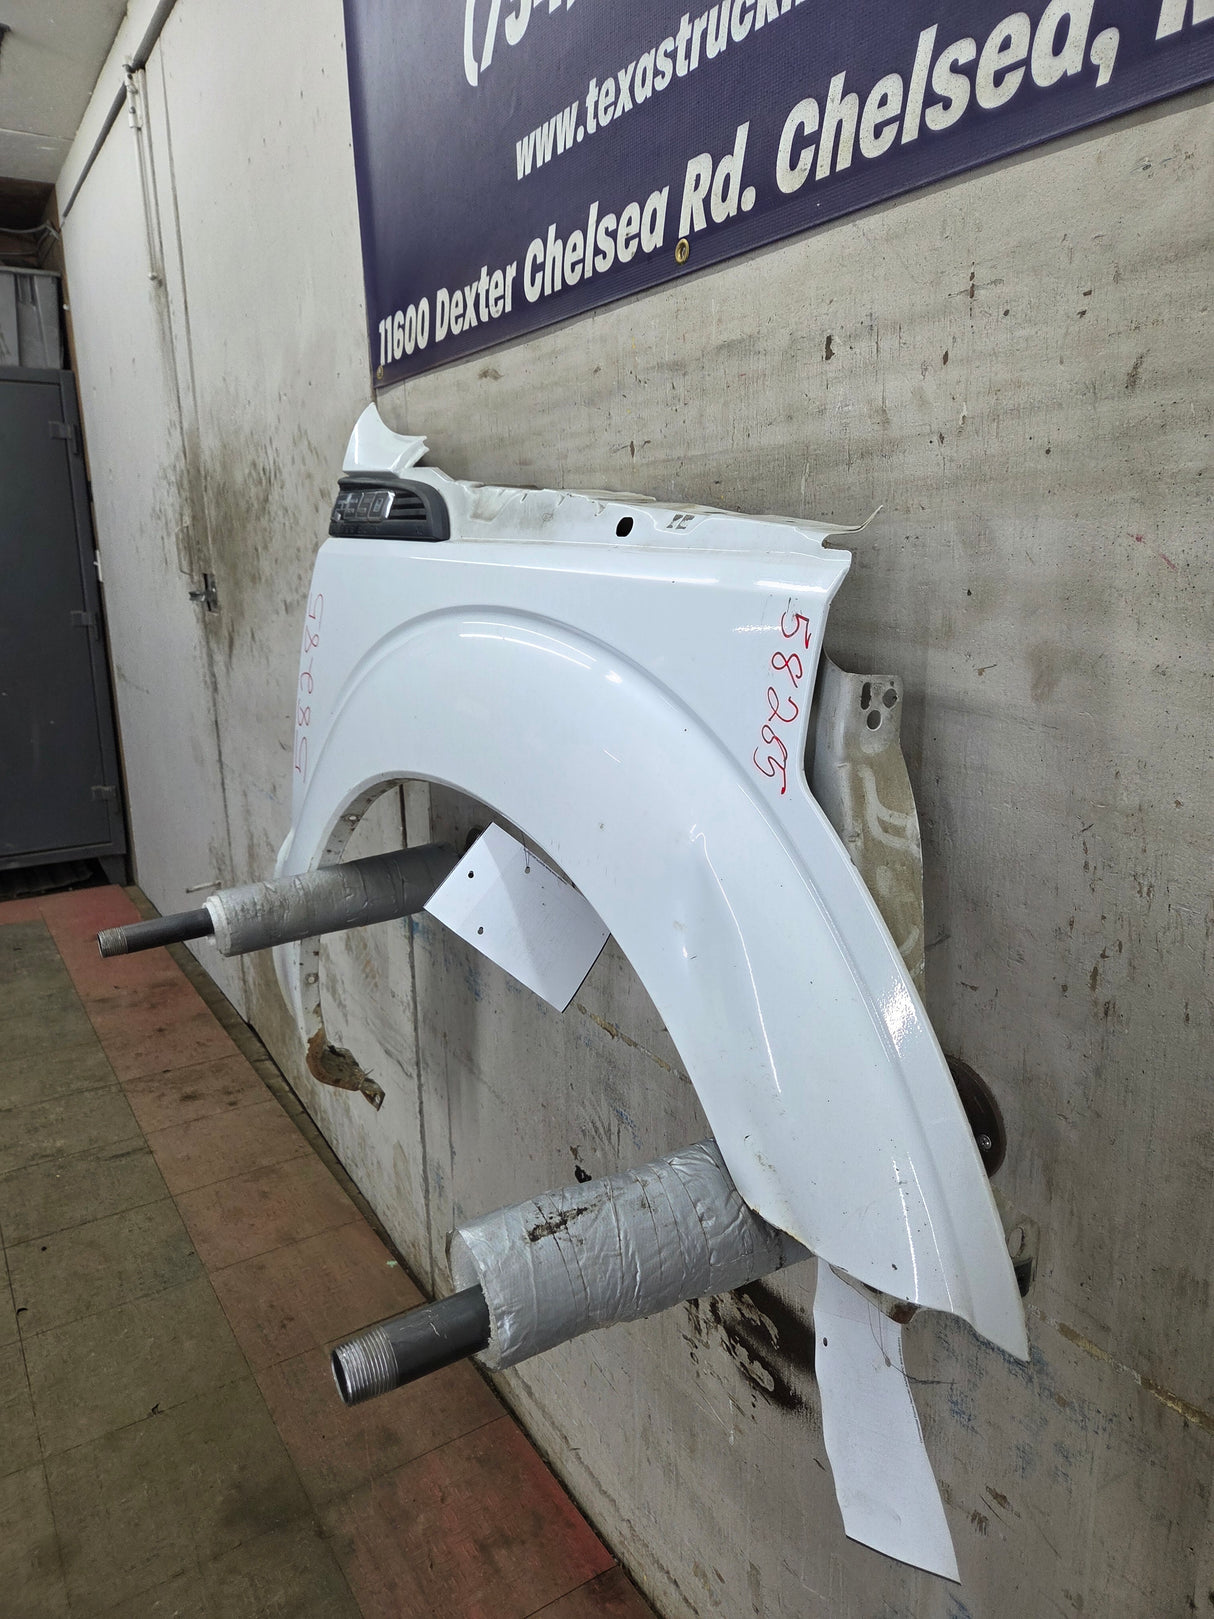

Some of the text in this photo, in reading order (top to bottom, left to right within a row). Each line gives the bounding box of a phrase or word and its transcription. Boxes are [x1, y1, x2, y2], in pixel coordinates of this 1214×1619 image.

[378, 0, 1120, 366] 11600 Dexter Chelsea Rd. Chelsea,
[516, 0, 806, 181] www.texastruc
